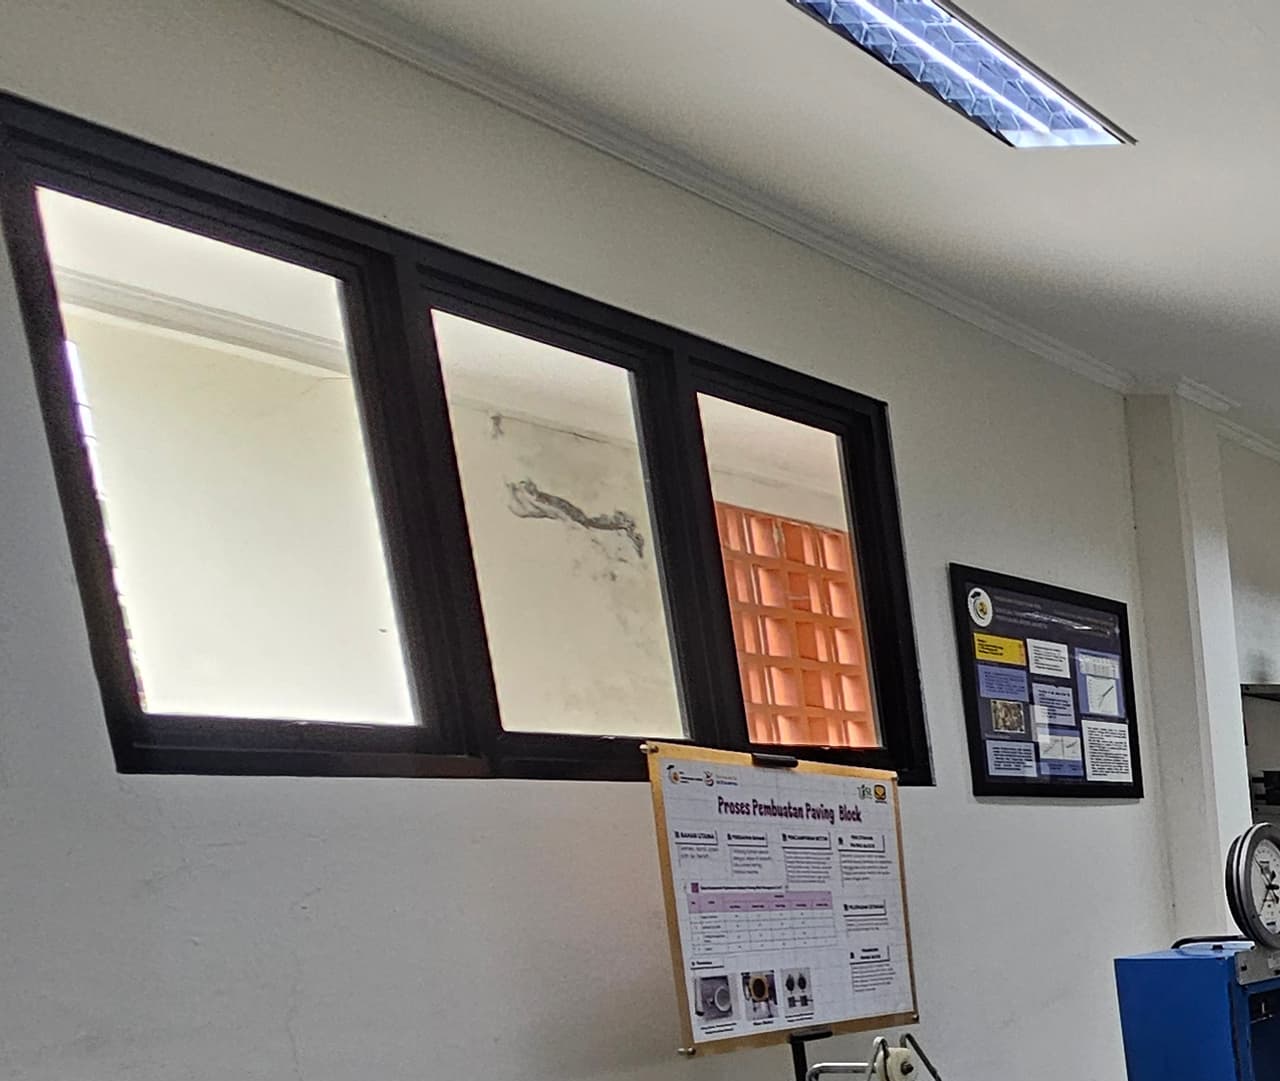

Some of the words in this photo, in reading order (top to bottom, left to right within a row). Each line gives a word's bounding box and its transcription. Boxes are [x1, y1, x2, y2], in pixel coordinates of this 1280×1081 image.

[718, 796, 751, 815] Proses
[752, 798, 804, 819] Pembuatan
[805, 802, 835, 825] Paving
[838, 804, 862, 822] Block
